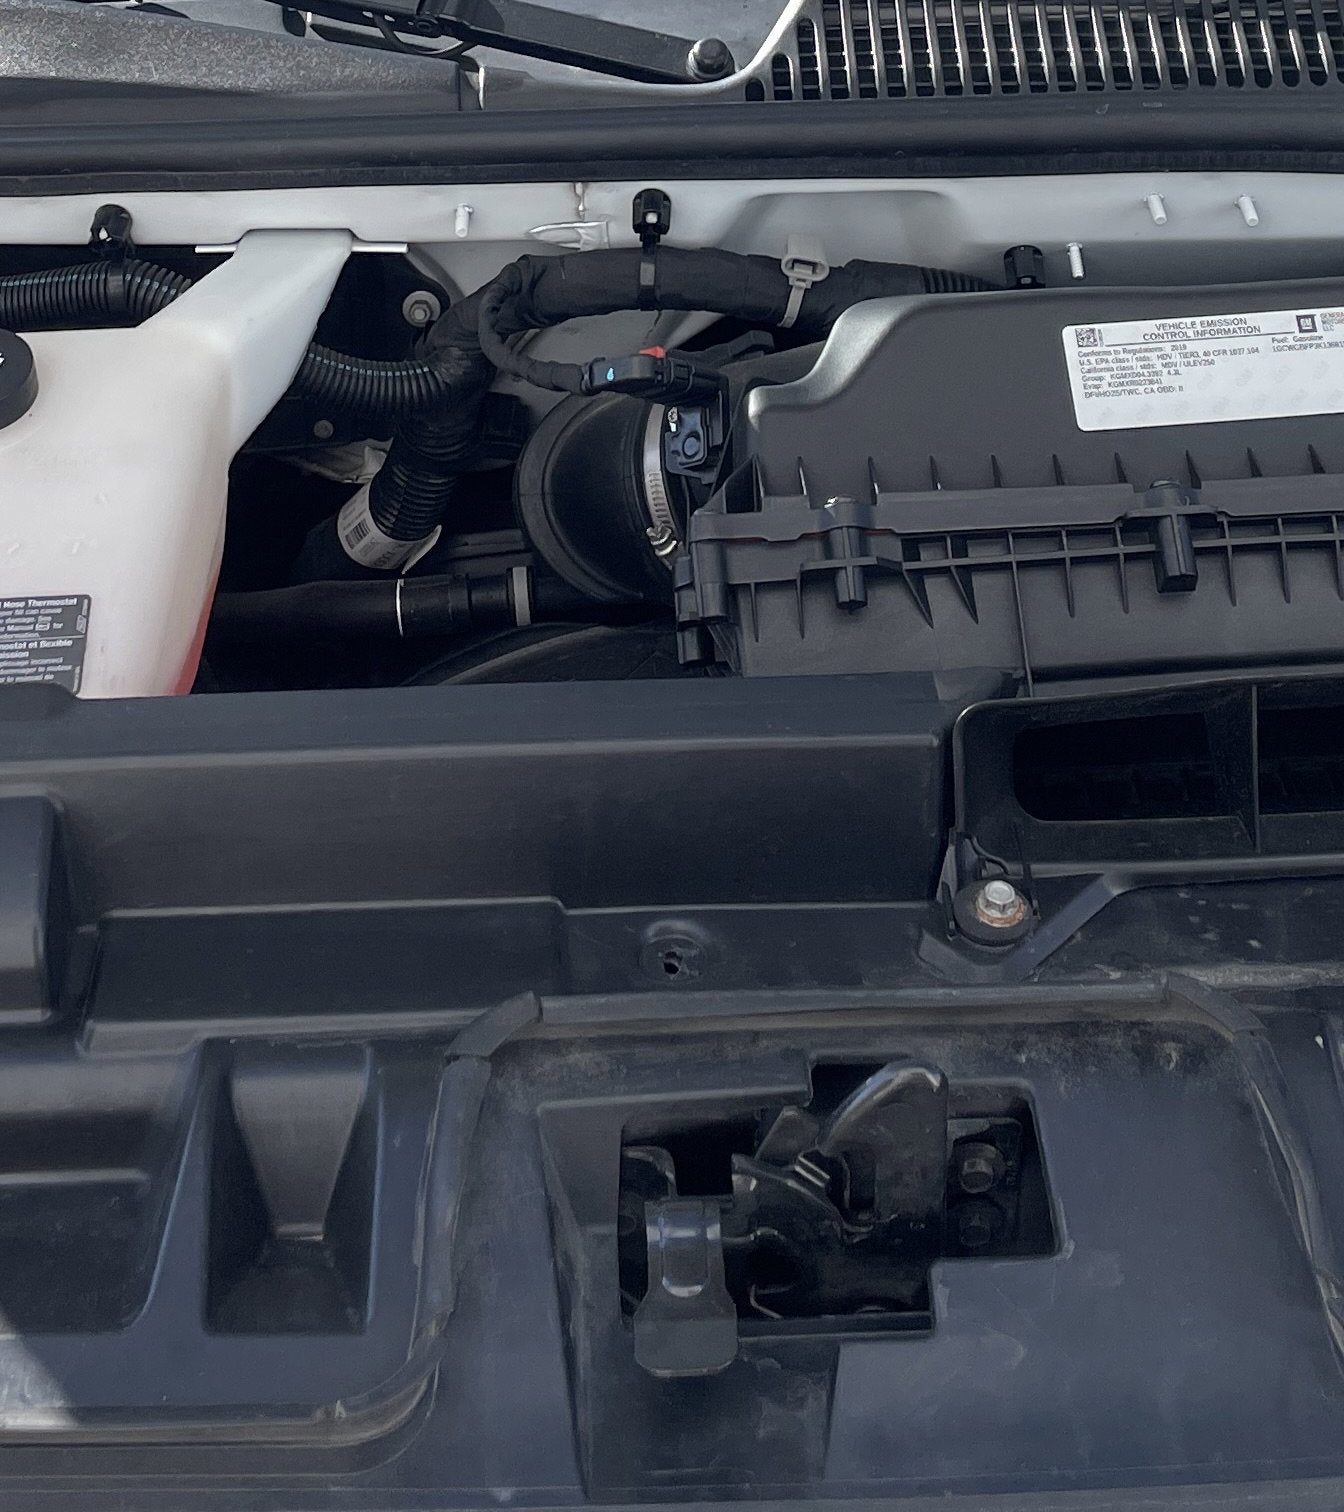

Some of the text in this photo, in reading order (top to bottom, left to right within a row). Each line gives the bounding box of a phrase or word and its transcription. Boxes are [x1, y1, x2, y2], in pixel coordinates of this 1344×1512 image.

[1155, 318, 1247, 330] VEHICLE EMISSION
[1142, 325, 1261, 340] CONTROL INFORMATION
[1077, 349, 1112, 357] Conforms
[1080, 365, 1114, 373] California
[1081, 374, 1106, 382] Group:
[28, 598, 77, 607] Thermostat
